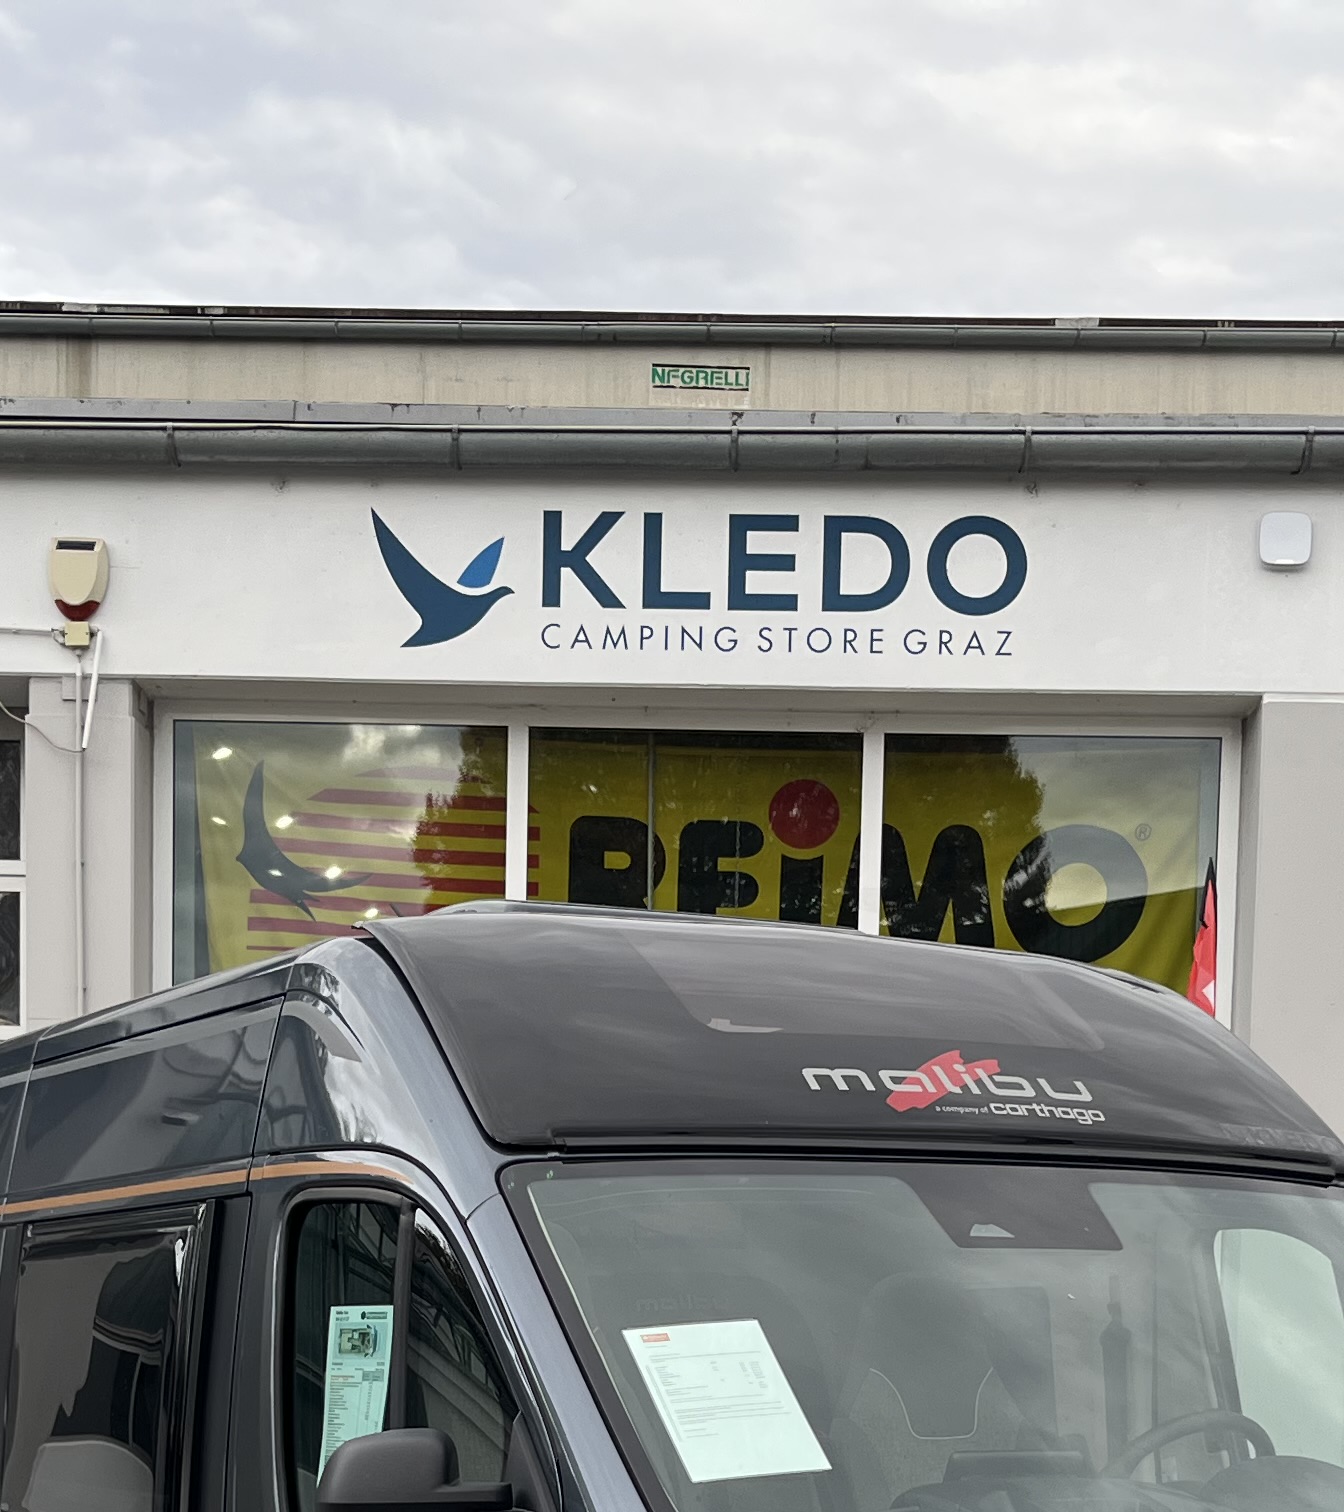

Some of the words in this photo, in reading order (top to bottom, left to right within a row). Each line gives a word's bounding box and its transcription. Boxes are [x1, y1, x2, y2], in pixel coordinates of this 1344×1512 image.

[541, 510, 1028, 616] KLEDO
[540, 623, 740, 652] CAMPING
[756, 626, 885, 655] STORE
[903, 628, 1013, 656] GRAZ
[801, 1063, 1093, 1101] malibu
[989, 1103, 1105, 1125] carthago
